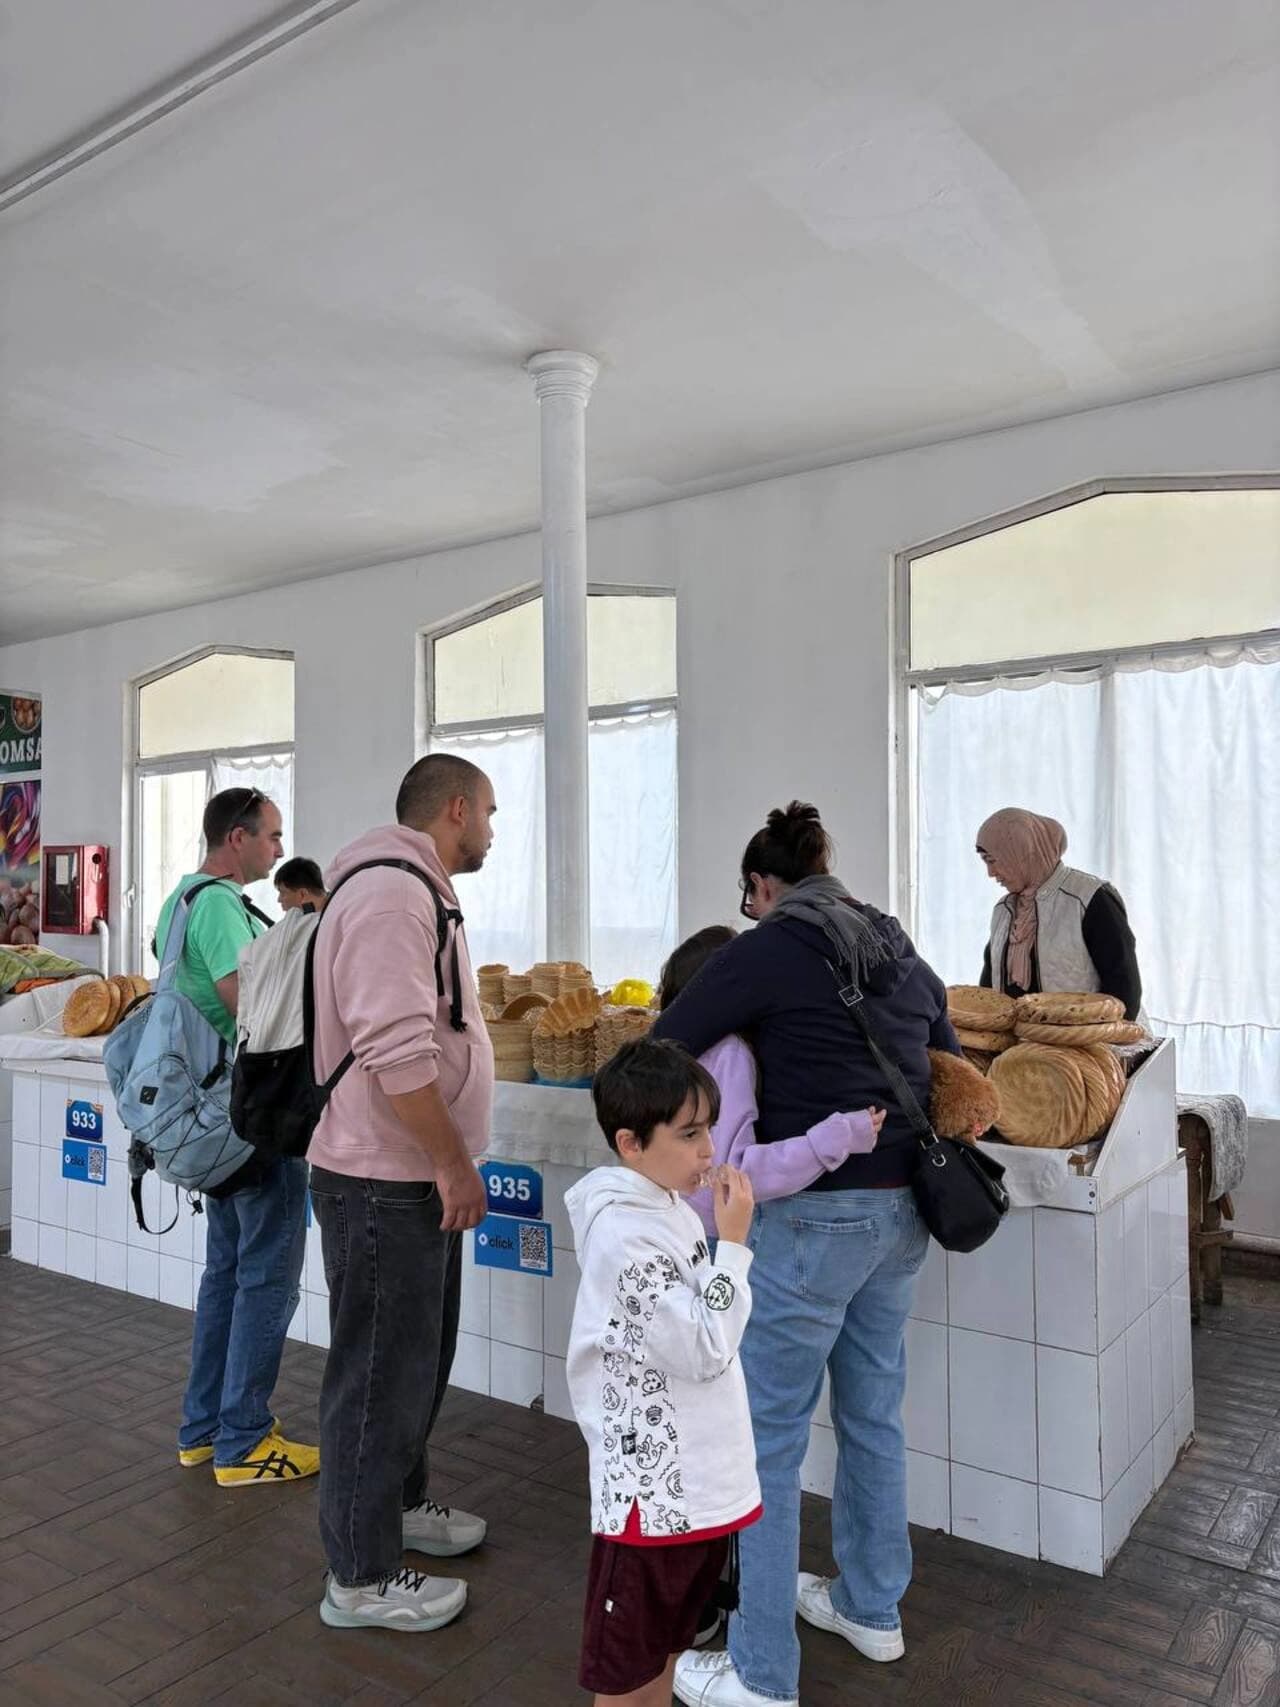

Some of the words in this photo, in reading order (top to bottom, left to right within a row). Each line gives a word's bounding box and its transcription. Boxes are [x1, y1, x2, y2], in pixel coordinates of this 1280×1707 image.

[72, 1110, 97, 1130] 933
[488, 1174, 531, 1201] 935
[488, 1235, 514, 1251] click
